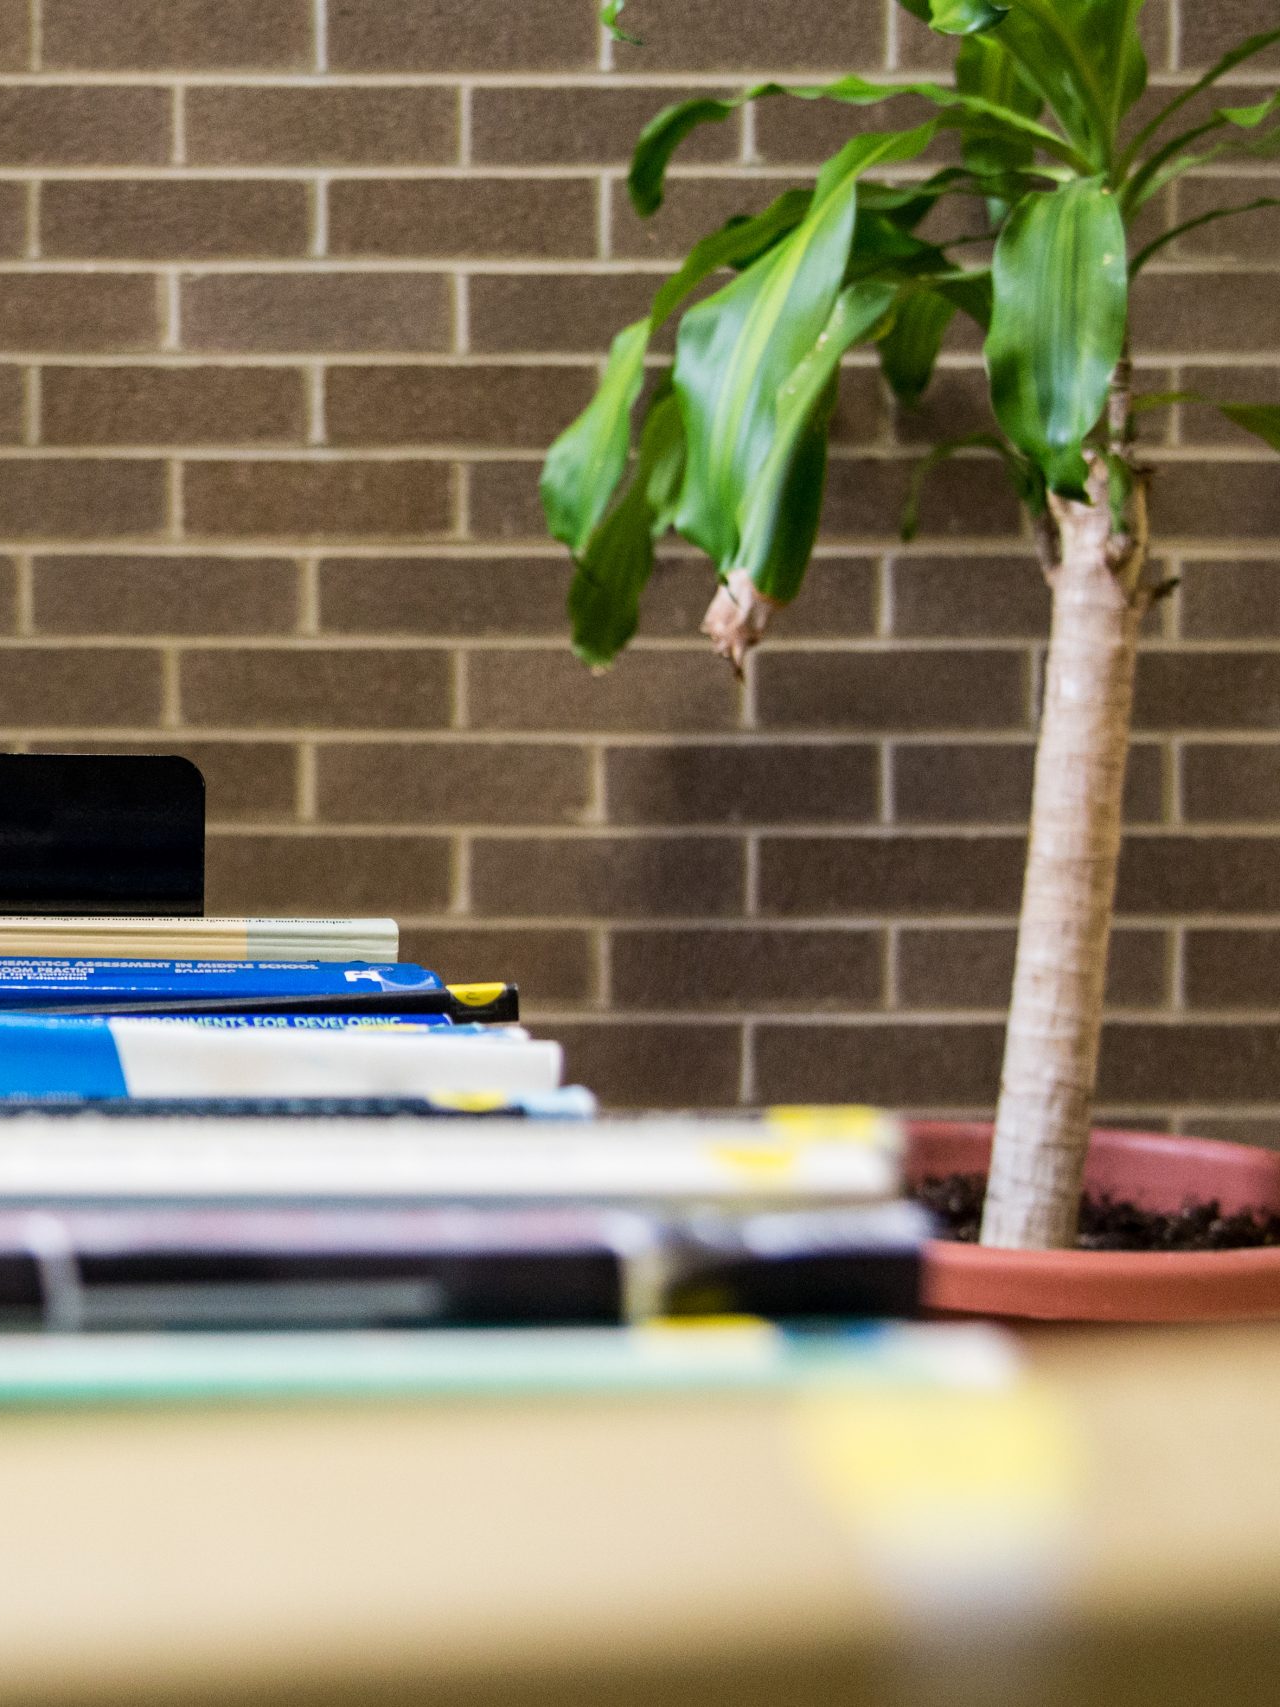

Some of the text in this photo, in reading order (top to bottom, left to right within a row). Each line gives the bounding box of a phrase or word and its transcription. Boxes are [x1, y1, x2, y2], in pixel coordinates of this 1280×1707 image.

[74, 961, 171, 969] ASSESSMENT
[197, 962, 254, 970] MIDDLE
[252, 1016, 289, 1029] FOR
